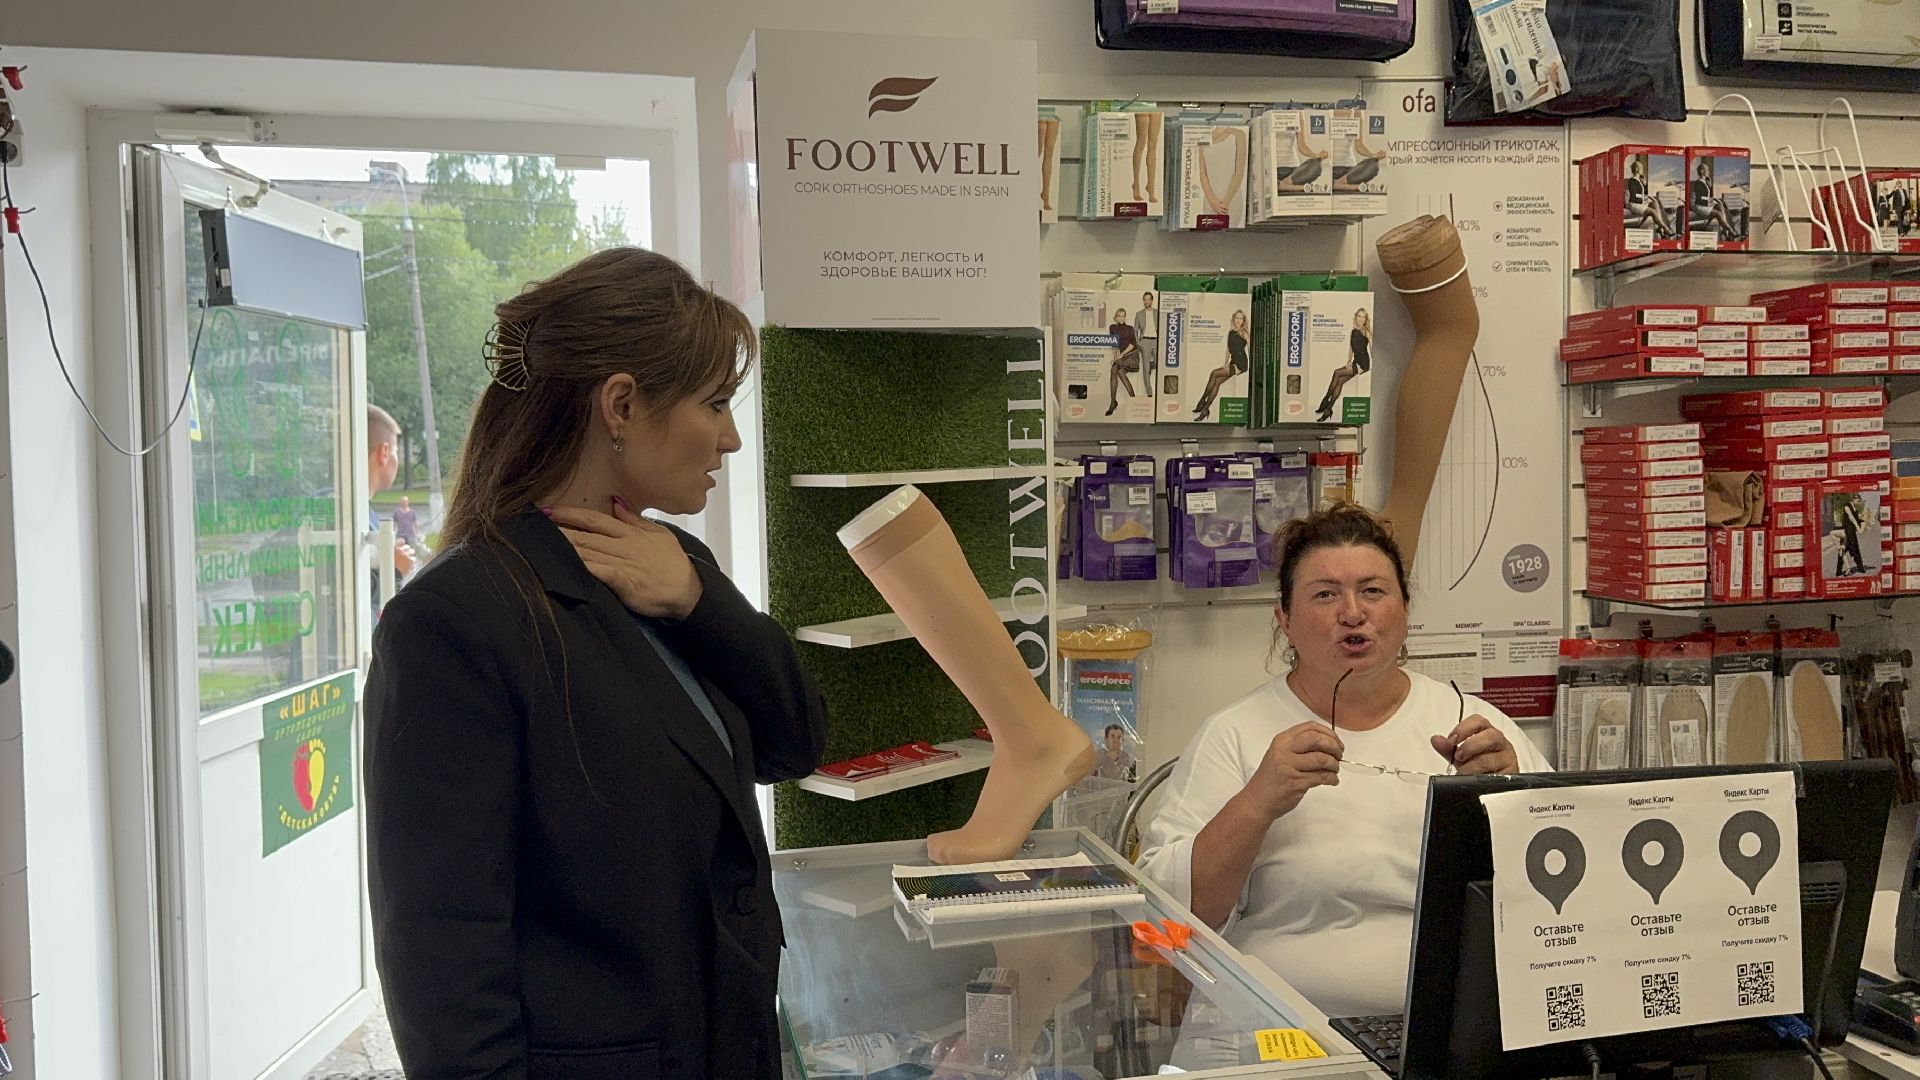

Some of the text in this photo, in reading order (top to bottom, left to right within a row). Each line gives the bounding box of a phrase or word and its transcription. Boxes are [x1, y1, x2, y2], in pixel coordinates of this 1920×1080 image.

[1402, 87, 1436, 113] ofa
[1494, 140, 1560, 152] ТРИКОТАЖ,
[786, 137, 1020, 176] FOOTWELL
[1416, 156, 1455, 164] хочется
[1457, 156, 1492, 164] носить
[1494, 155, 1534, 165] каждый
[1536, 156, 1560, 166] день
[794, 182, 1010, 198] CORK ORTHOSHOES MADE IN SPAIN
[1457, 220, 1480, 232] 40%
[823, 250, 984, 263] КОМФОРТ, ЛЕГКОСТЬ И
[820, 266, 988, 279] ЗДОРОВЬЕ ВАШИХ НОГ!
[1069, 335, 1118, 345] ERGOFORMA
[1482, 366, 1506, 378] 70%
[1502, 457, 1529, 469] 100%
[1508, 556, 1543, 576] 1928
[279, 683, 341, 721] «ШАГ»
[274, 701, 347, 742] ОРТОПЕДИЧЕСКИЙ
[296, 725, 322, 744] САЛОН
[1724, 788, 1770, 798] Яндекс Карты
[1628, 795, 1674, 806] Яндекс Карты
[1528, 804, 1575, 814] Яндекс Карты
[1727, 902, 1777, 917] Оставьте
[1630, 912, 1682, 927] Оставьте
[1737, 916, 1770, 927] отзыв
[1533, 922, 1584, 937] Оставьте
[1641, 925, 1674, 937] отзыв
[1544, 936, 1577, 948] отзыв
[1722, 934, 1789, 949] Получите скидку 7%
[1530, 956, 1597, 972] Получите скидку 7%
[1624, 954, 1691, 969] Получите скидку 7%
